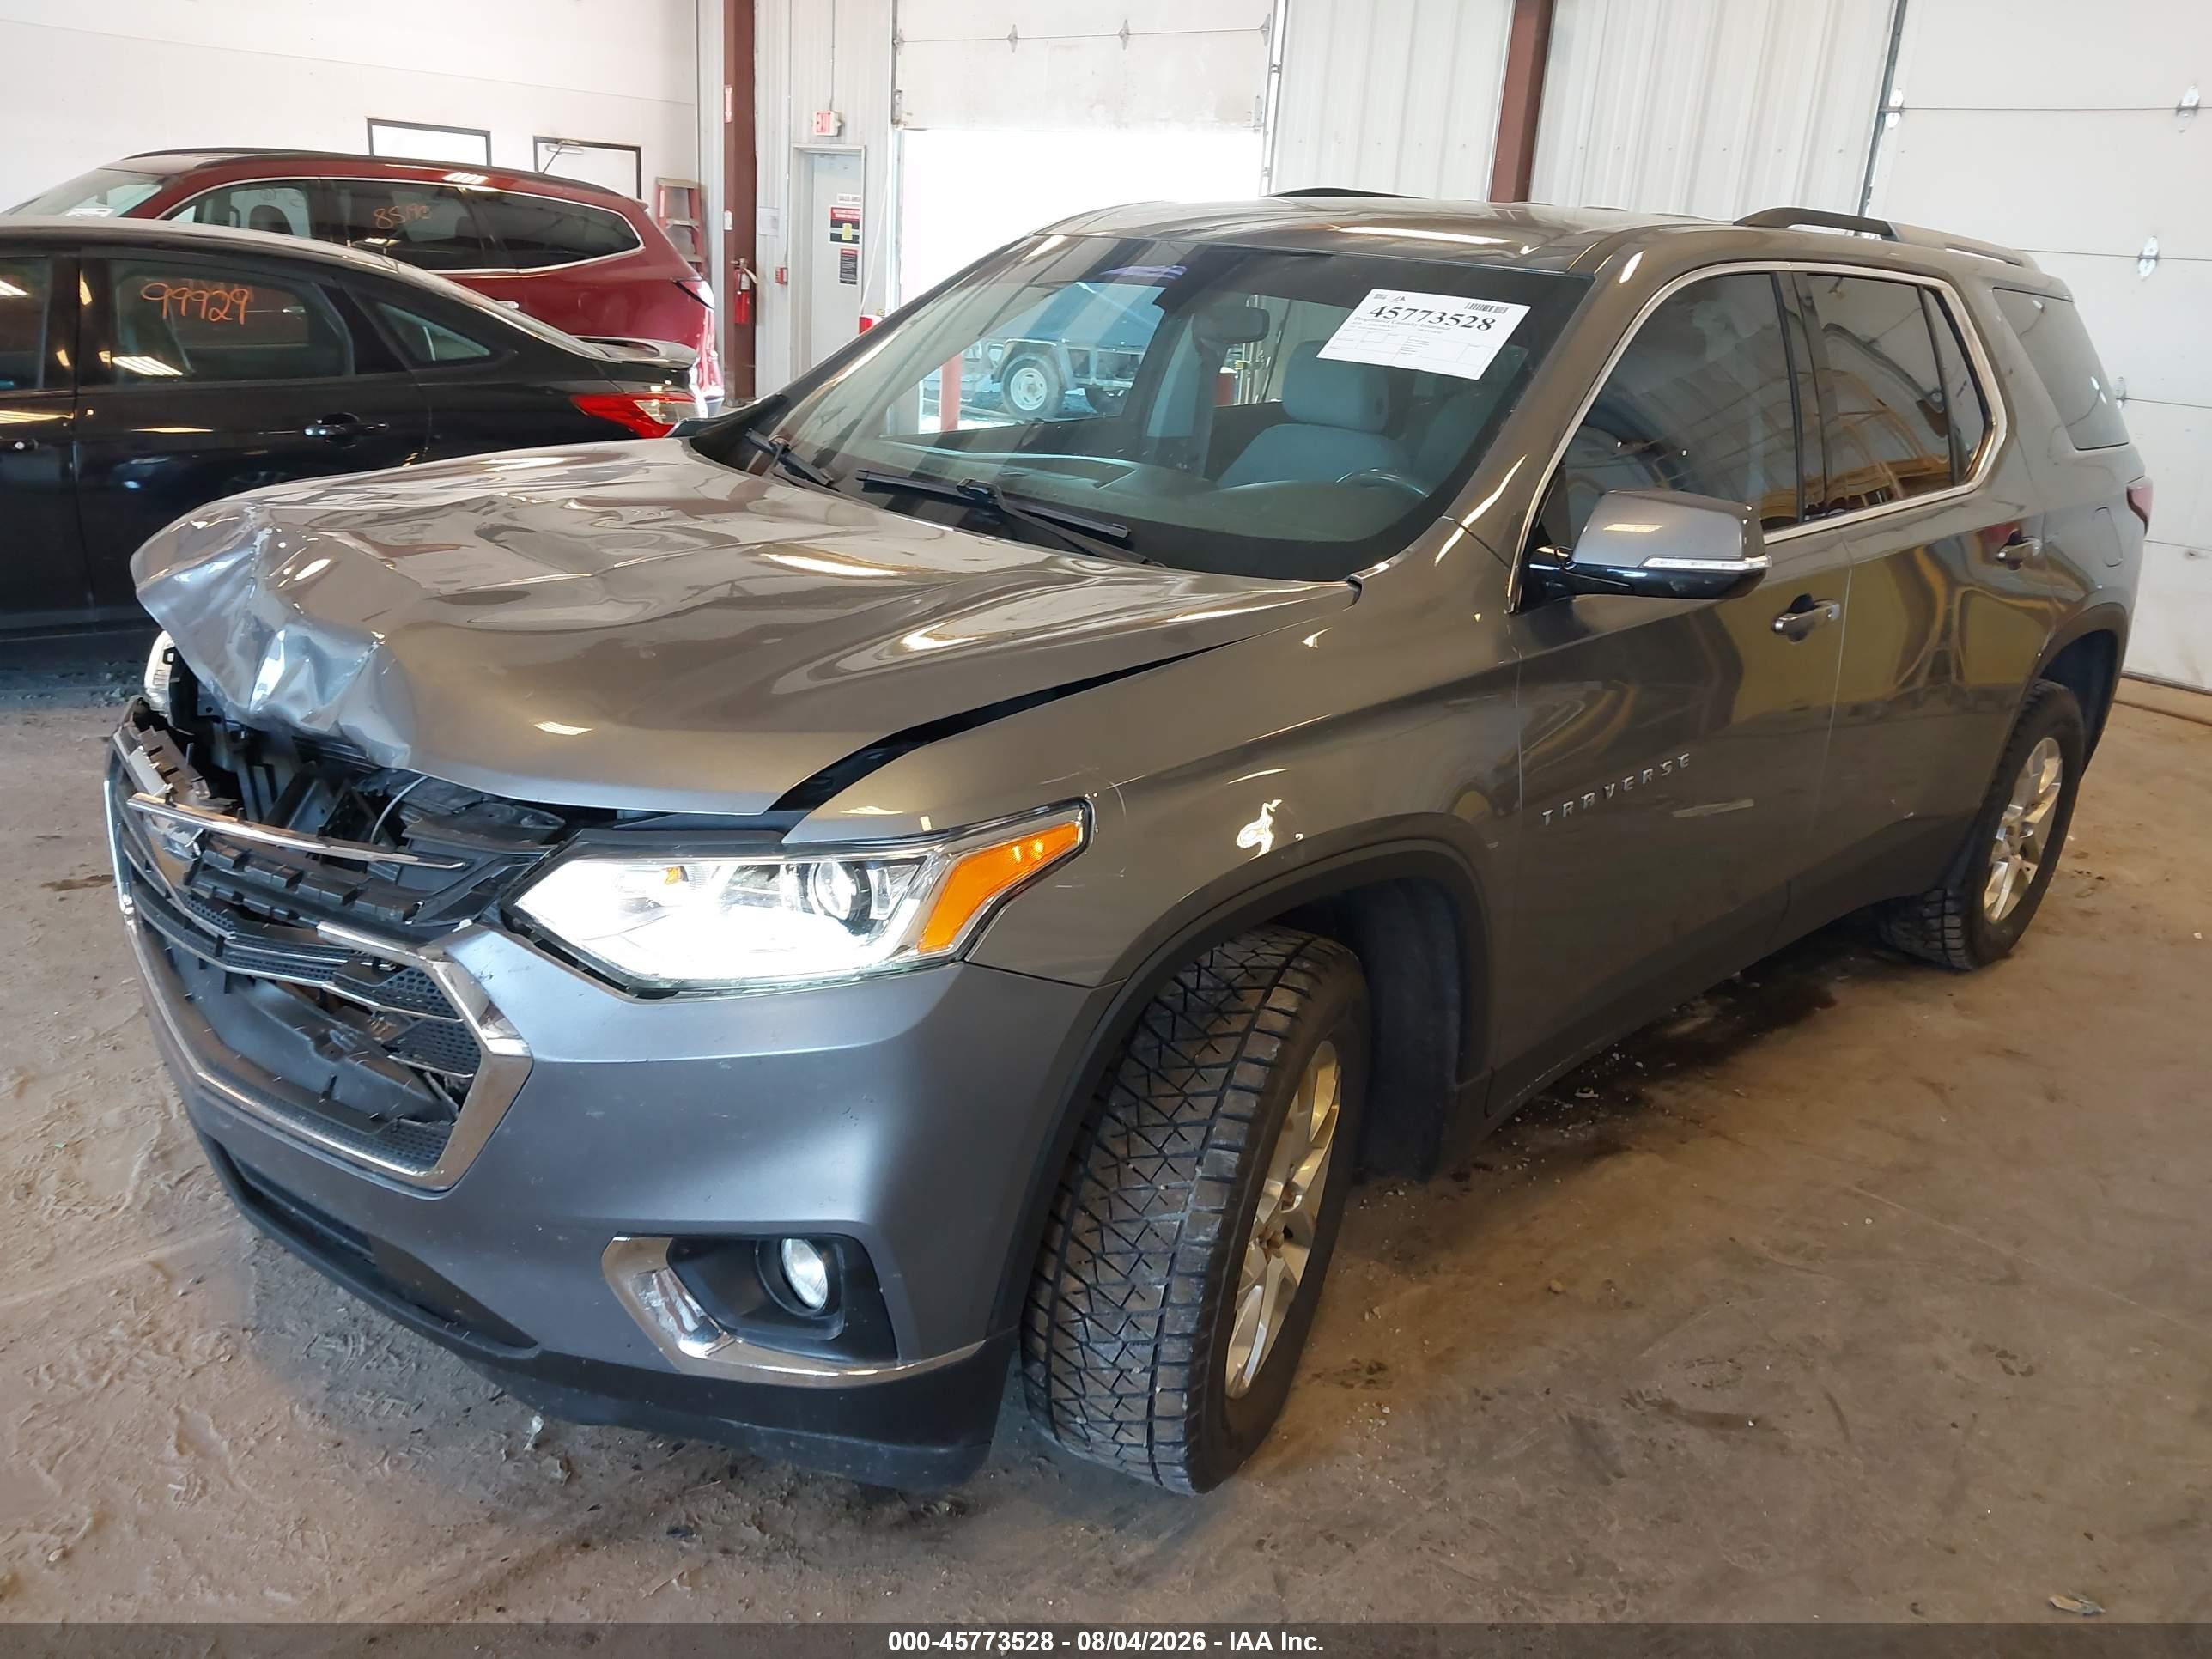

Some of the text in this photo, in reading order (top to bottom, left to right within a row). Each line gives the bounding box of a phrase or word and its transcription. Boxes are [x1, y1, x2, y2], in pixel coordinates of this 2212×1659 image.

[140, 282, 249, 325] 99929
[1369, 305, 1497, 331] 45773528
[1541, 753, 1691, 826] TRAVERSE
